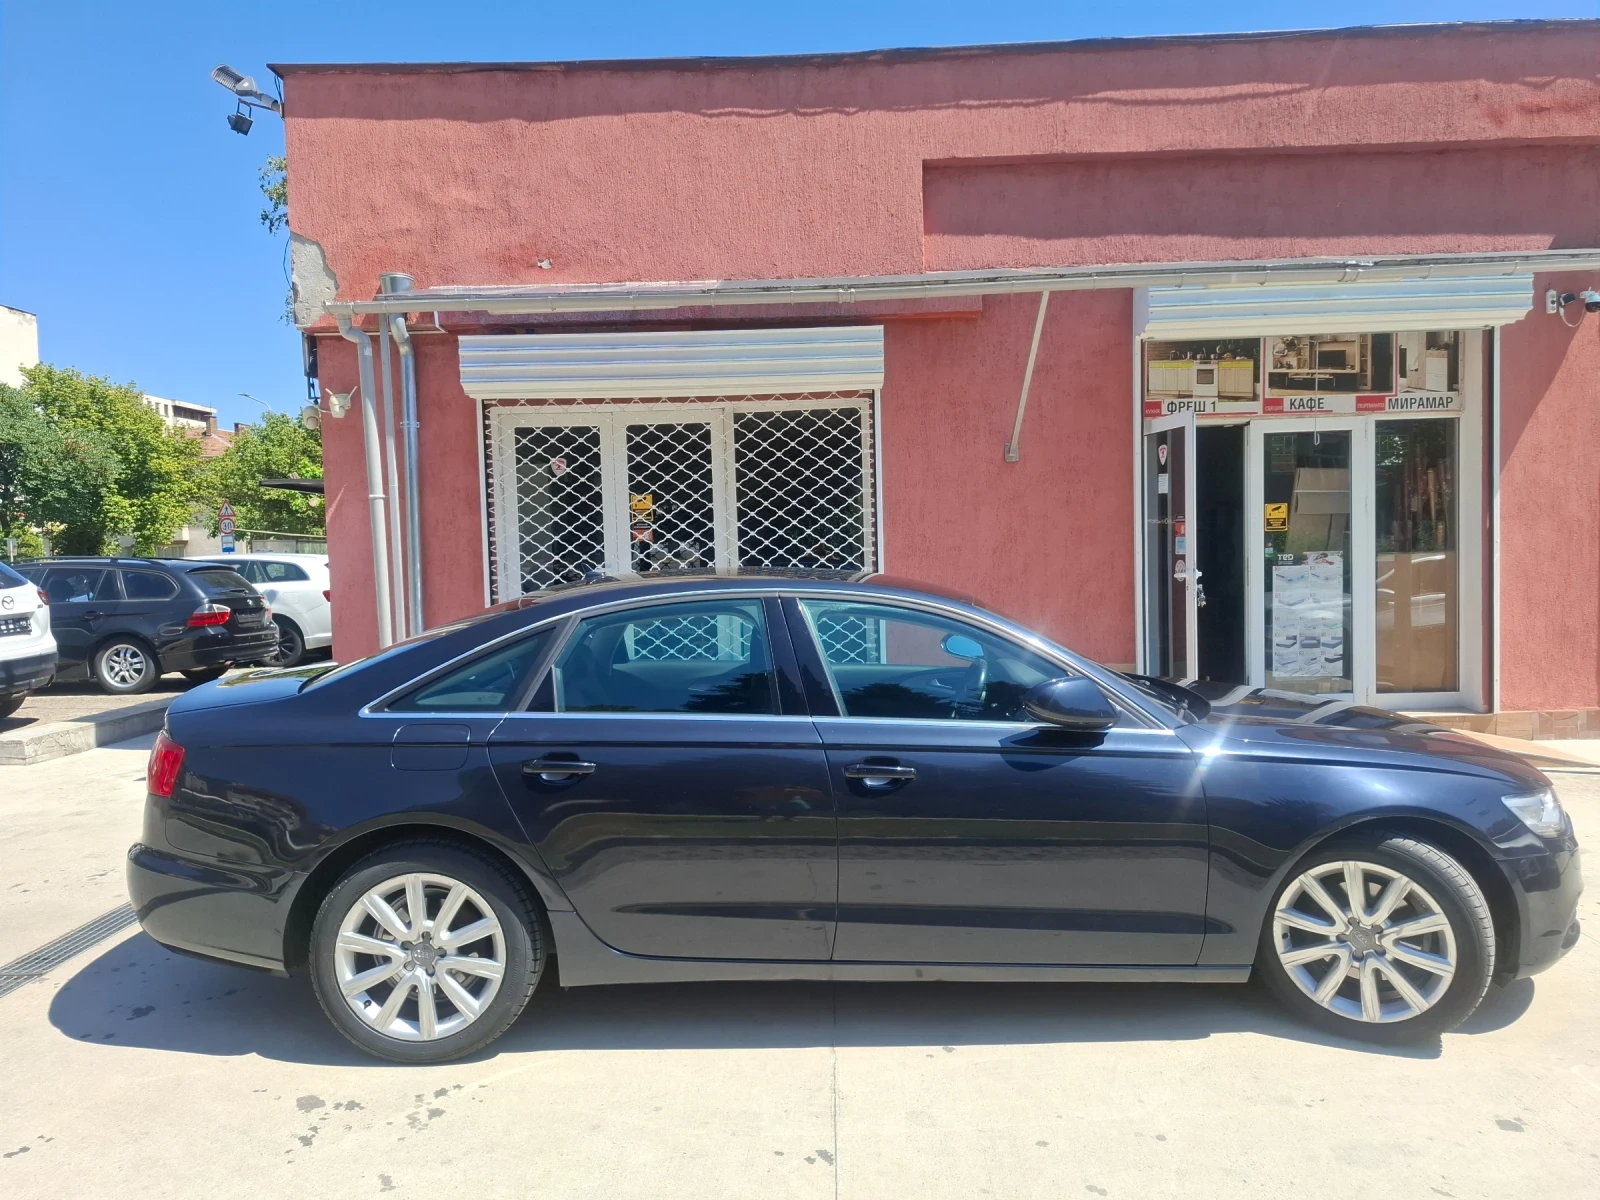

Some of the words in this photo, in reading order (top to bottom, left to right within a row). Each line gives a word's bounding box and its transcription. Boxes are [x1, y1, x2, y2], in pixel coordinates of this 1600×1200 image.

[1210, 400, 1216, 412] 1
[1289, 397, 1325, 411] КАФЕ
[1388, 396, 1453, 410] МИРАМАР
[222, 521, 232, 531] 30
